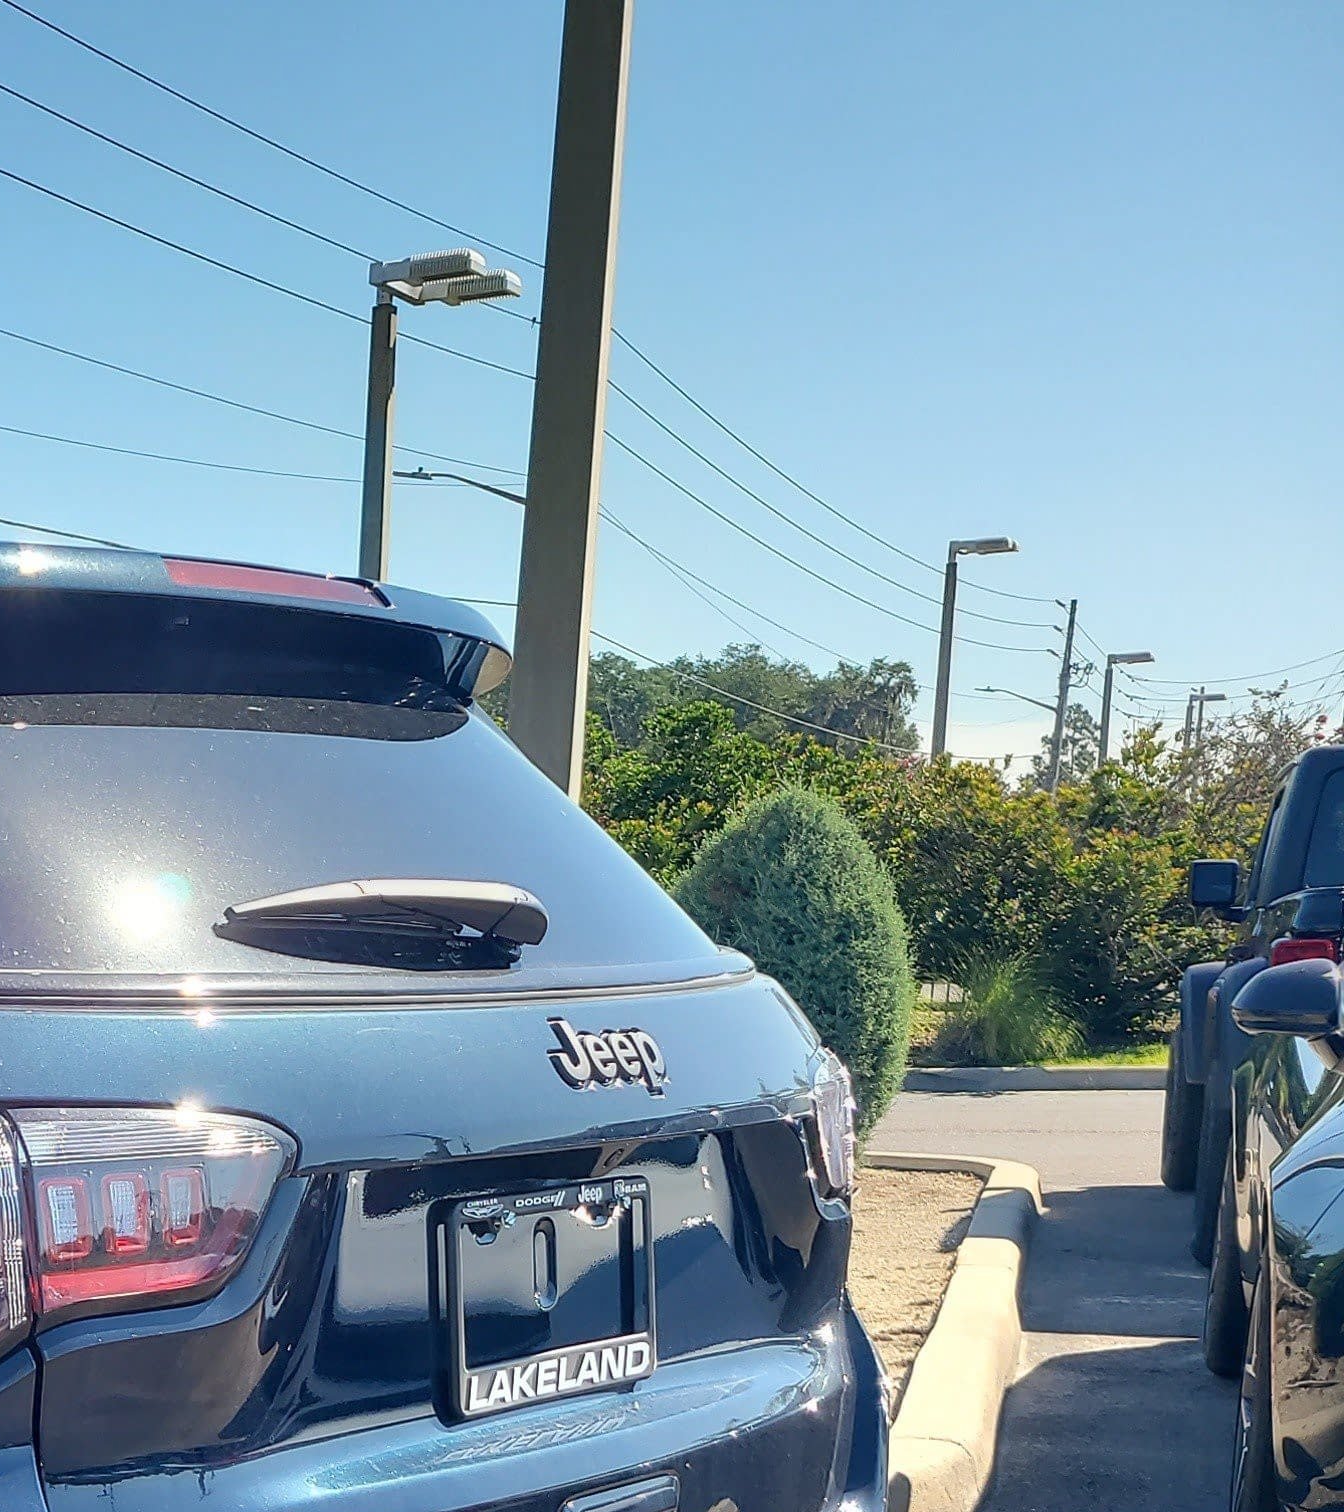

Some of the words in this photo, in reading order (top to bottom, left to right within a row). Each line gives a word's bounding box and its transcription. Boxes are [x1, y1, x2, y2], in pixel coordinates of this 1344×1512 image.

[546, 1016, 669, 1099] Jeep
[578, 1185, 603, 1204] Jeep
[625, 1183, 647, 1194] RAM
[469, 1341, 650, 1411] LAKELAND
